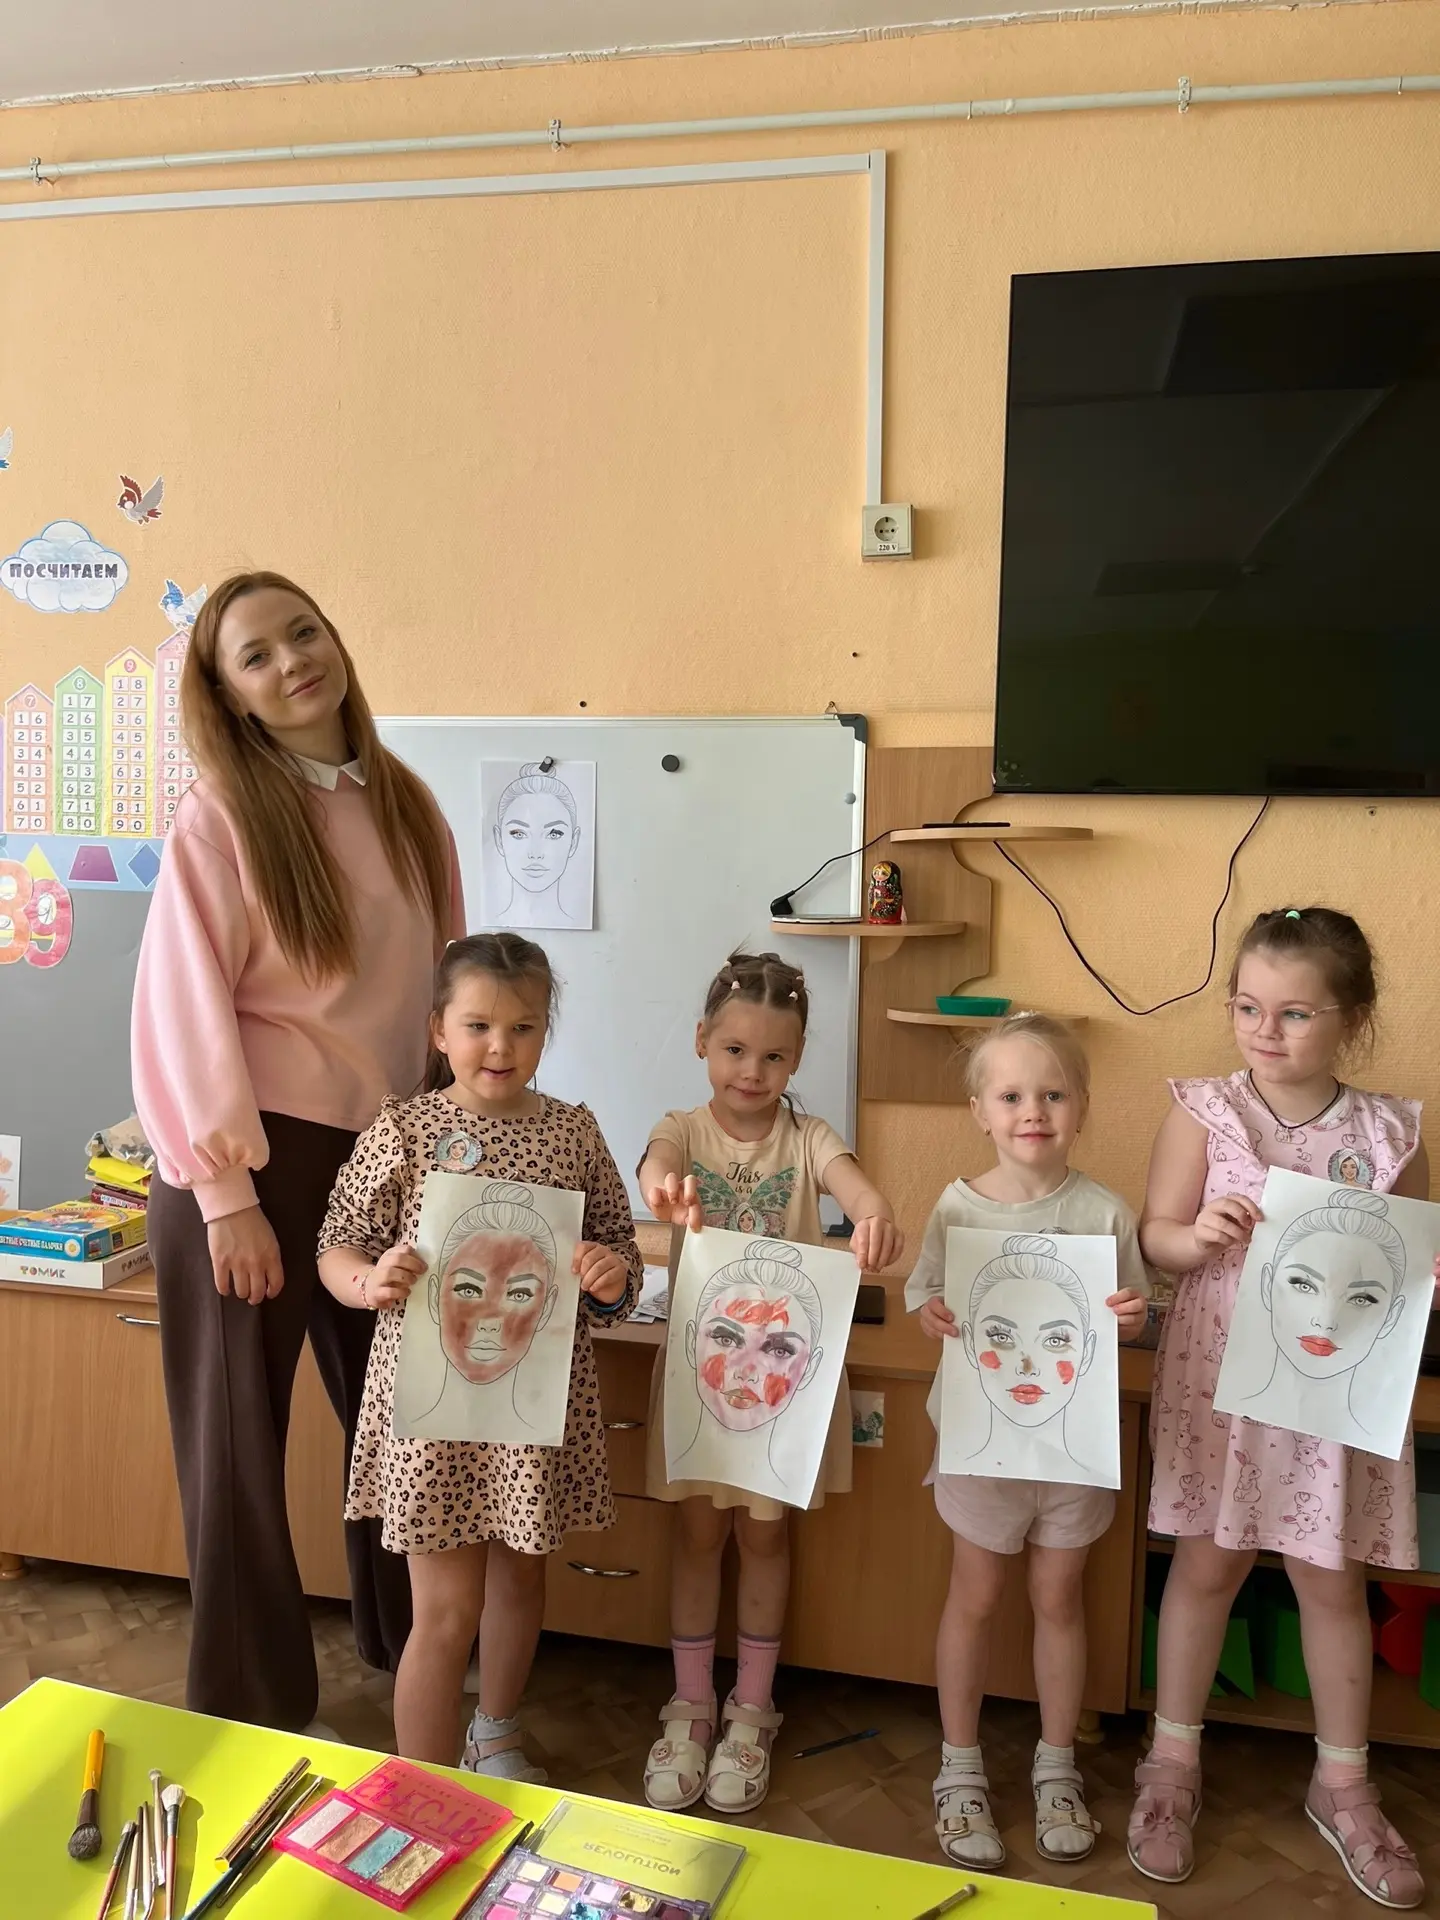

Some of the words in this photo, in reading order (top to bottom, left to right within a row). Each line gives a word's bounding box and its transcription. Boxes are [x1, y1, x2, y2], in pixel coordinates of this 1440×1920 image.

[9, 563, 118, 578] ПОСЧИТАЕМ
[169, 661, 174, 671] 1
[118, 679, 123, 689] 1
[135, 679, 142, 689] 8
[168, 679, 176, 689] 2
[68, 696, 73, 706] 1
[84, 696, 92, 706] 7
[117, 697, 124, 706] 2
[134, 697, 142, 707] 7
[168, 696, 176, 706] 3
[19, 714, 24, 723] 1
[35, 714, 42, 724] 6
[67, 714, 74, 723] 2
[84, 714, 92, 724] 6
[117, 714, 124, 724] 3
[134, 715, 142, 725] 6
[168, 714, 176, 724] 4
[17, 731, 24, 741] 2
[35, 732, 42, 742] 5
[67, 731, 74, 741] 3
[84, 732, 92, 741] 5
[117, 732, 124, 742] 4
[134, 732, 142, 742] 5
[168, 732, 175, 742] 5
[17, 748, 24, 758] 3
[34, 749, 42, 759] 4
[66, 748, 74, 758] 4
[84, 749, 92, 759] 4
[117, 749, 124, 759] 5
[134, 750, 142, 760] 4
[168, 750, 176, 760] 6
[17, 766, 24, 775] 4
[35, 766, 42, 776] 3
[67, 766, 74, 776] 5
[84, 767, 91, 776] 3
[117, 767, 124, 777] 6
[134, 768, 141, 778] 3
[168, 767, 175, 777] 7
[186, 768, 193, 778] 3
[17, 783, 24, 793] 5
[35, 784, 42, 793] 2
[66, 784, 74, 793] 6
[84, 784, 91, 794] 2
[117, 785, 124, 794] 7
[134, 785, 141, 795] 2
[168, 785, 175, 795] 8
[17, 800, 25, 810] 6
[36, 801, 40, 811] 1
[67, 801, 74, 810] 7
[85, 802, 90, 811] 1
[117, 802, 124, 812] 8
[135, 803, 140, 813] 1
[168, 802, 175, 813] 9
[17, 817, 25, 827] 7
[34, 818, 42, 827] 0
[67, 818, 74, 828] 8
[83, 819, 92, 828] 0
[116, 820, 124, 829] 9
[133, 820, 142, 830] 0
[726, 1161, 764, 1183] This
[735, 1185, 744, 1194] is
[20, 1265, 66, 1279] ТОМИК
